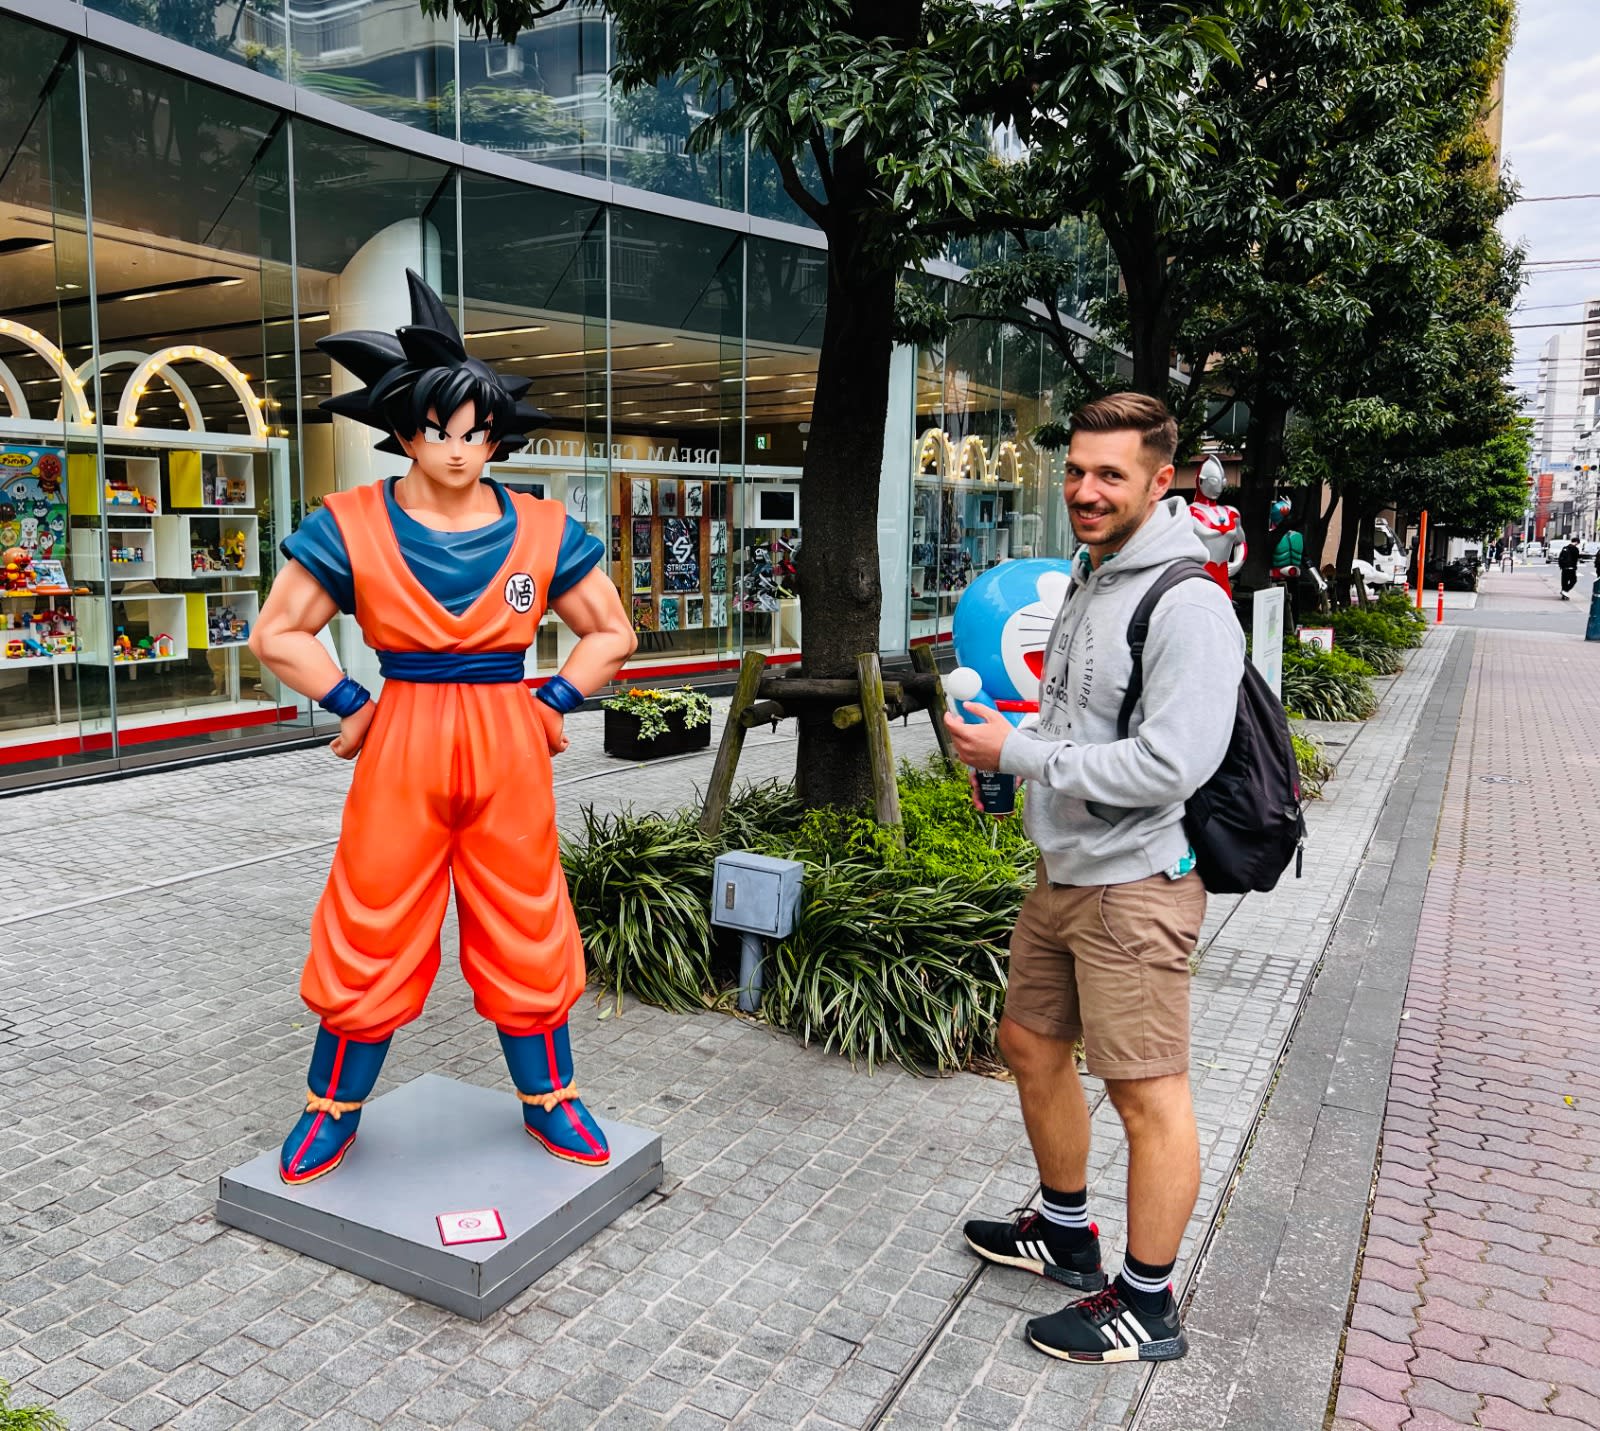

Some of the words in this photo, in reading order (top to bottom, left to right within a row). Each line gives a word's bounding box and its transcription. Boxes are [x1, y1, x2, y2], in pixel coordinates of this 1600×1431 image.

[509, 577, 532, 606] 悟
[1083, 616, 1094, 653] THREE
[1079, 657, 1094, 709] STRIPES
